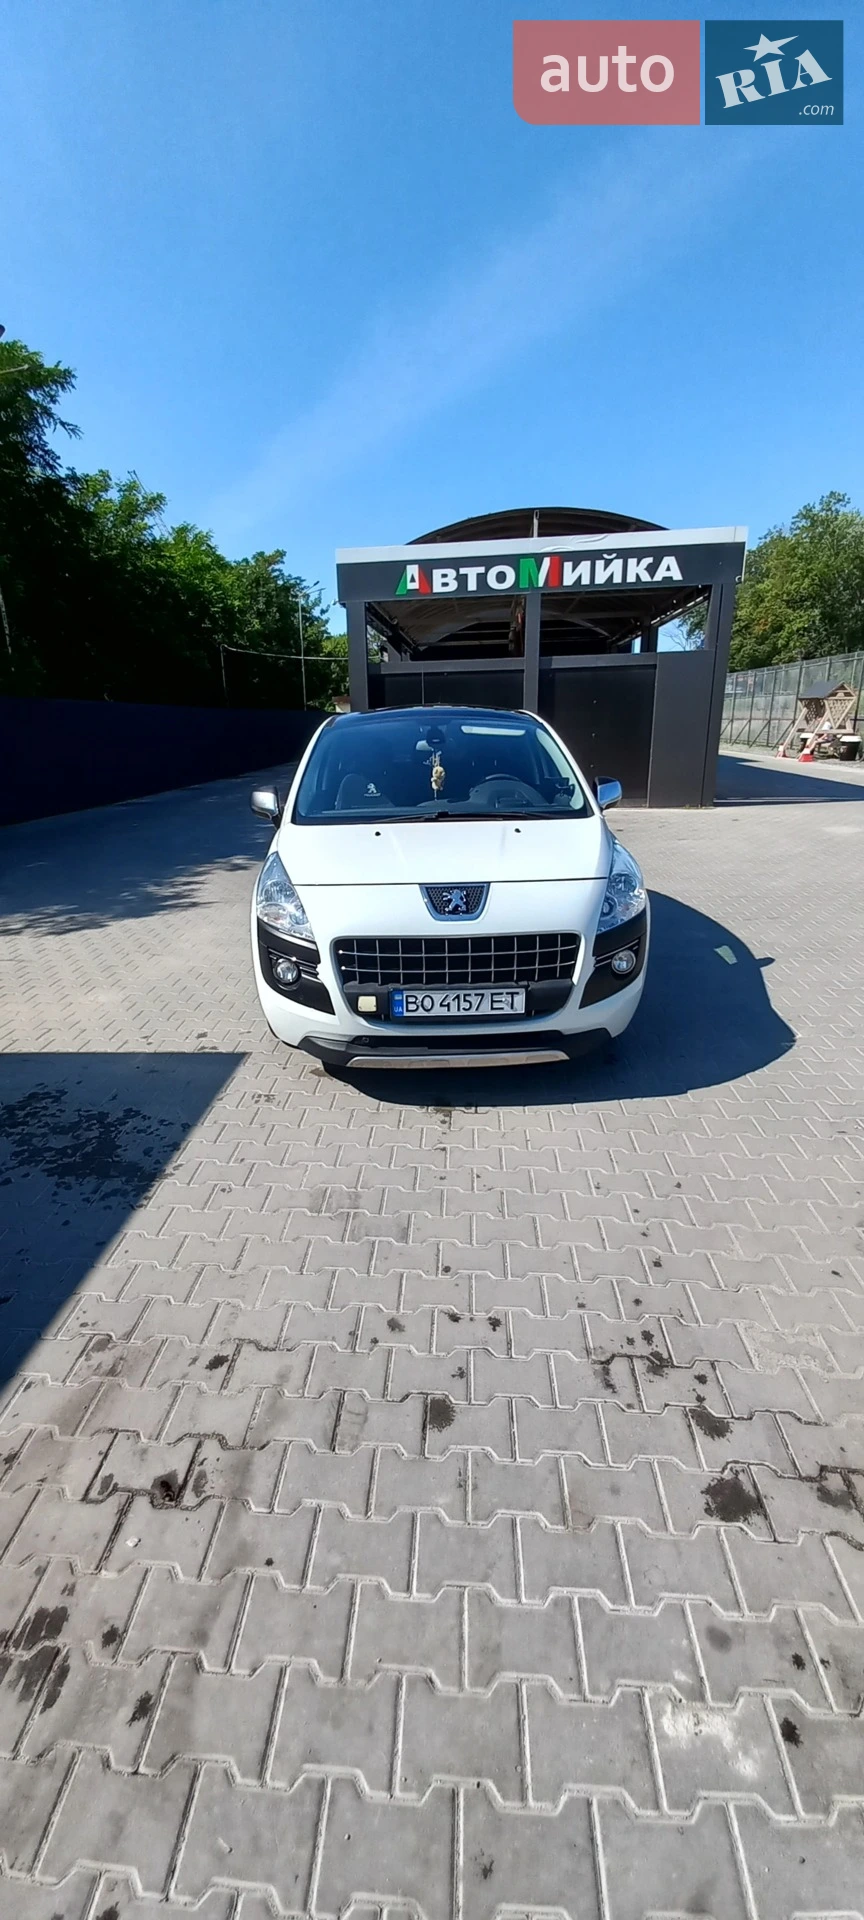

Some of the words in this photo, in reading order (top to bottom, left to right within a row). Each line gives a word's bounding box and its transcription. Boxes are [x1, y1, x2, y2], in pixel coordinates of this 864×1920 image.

[393, 1005, 403, 1013] UA
[405, 994, 435, 1013] BO
[439, 992, 485, 1012] 4157
[490, 991, 520, 1011] ET
